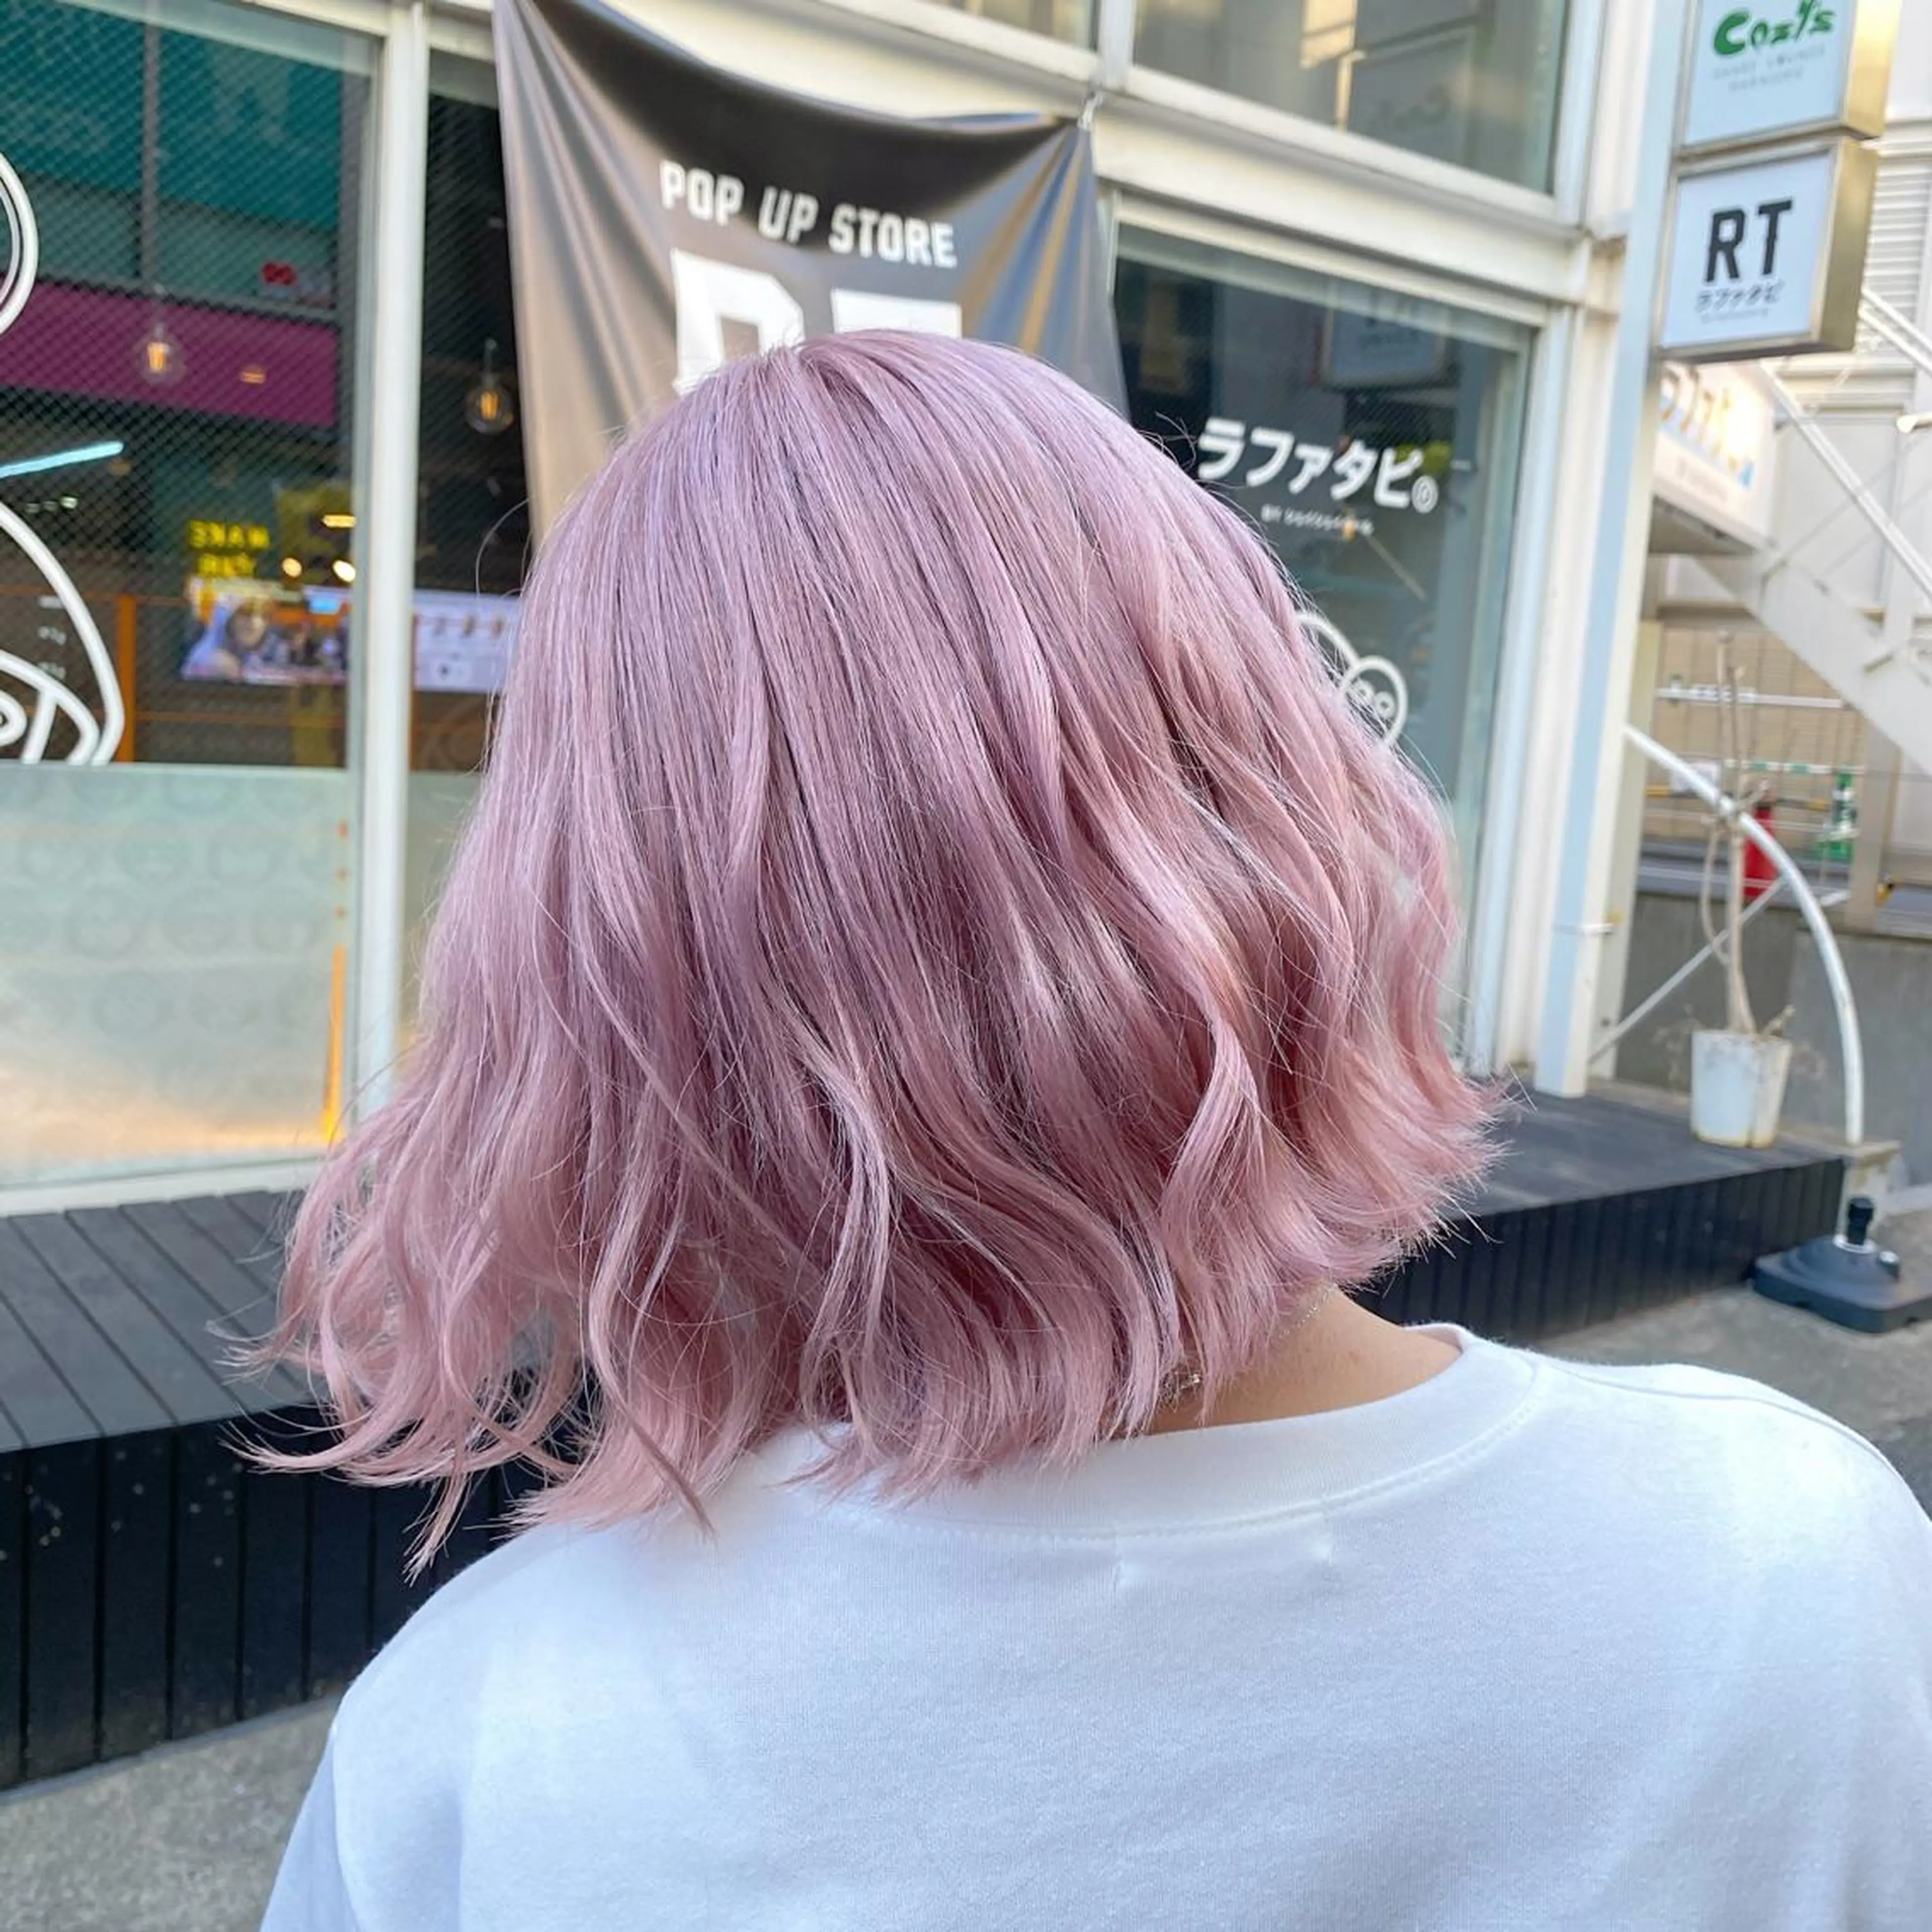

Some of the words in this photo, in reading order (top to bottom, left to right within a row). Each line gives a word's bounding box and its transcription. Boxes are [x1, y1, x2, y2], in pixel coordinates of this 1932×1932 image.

[660, 160, 744, 225] POP
[759, 186, 819, 242] UP
[829, 205, 957, 268] STORE
[1705, 200, 1793, 283] RT
